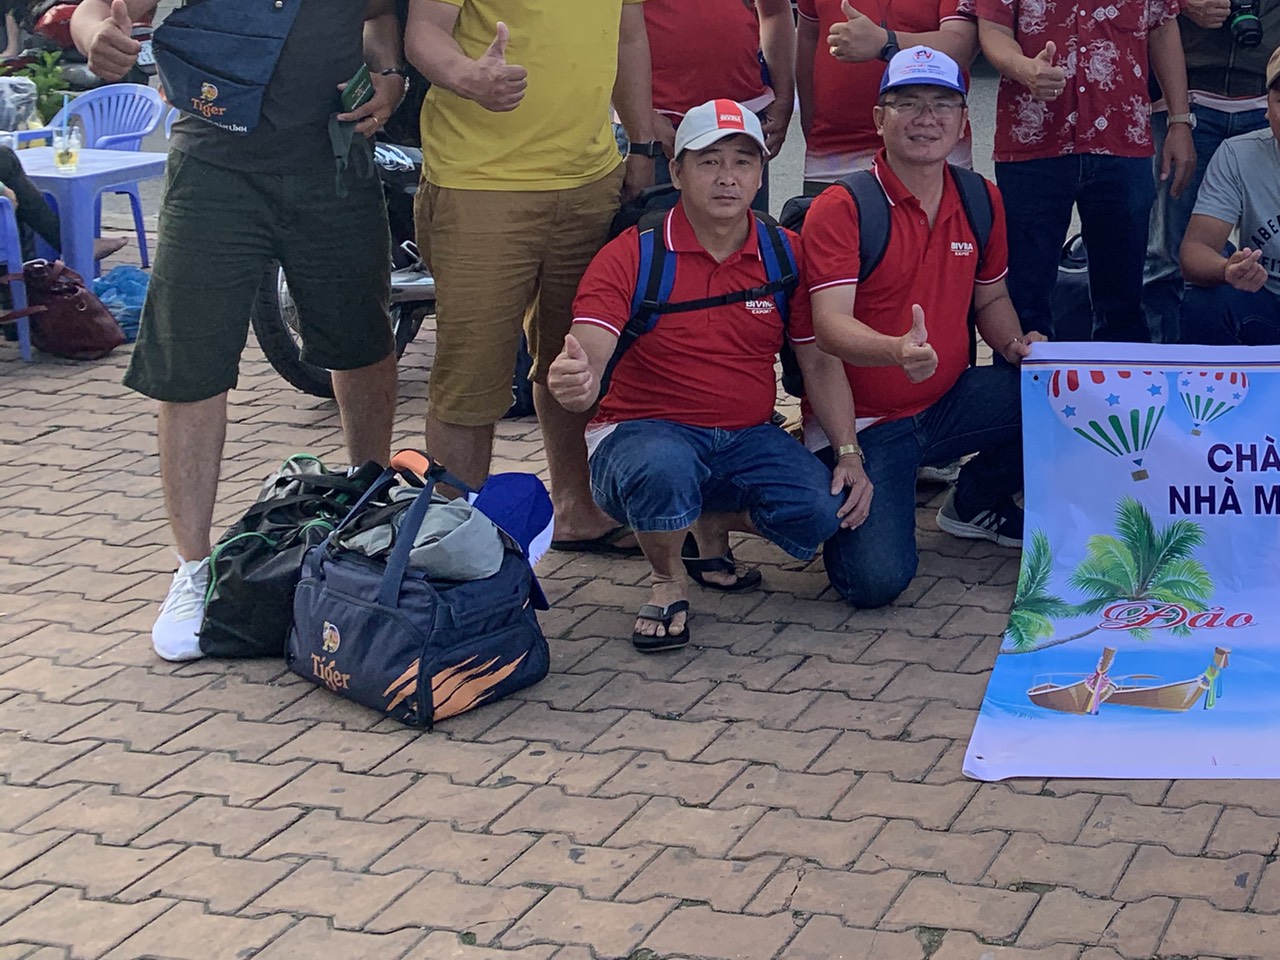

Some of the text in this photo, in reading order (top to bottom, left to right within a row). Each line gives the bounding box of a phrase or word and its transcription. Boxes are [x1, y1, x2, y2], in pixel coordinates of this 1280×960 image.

[191, 97, 226, 118] Tiger
[745, 300, 774, 308] BIVIN
[1169, 477, 1243, 515] NHÀ
[311, 652, 350, 691] Tiger
